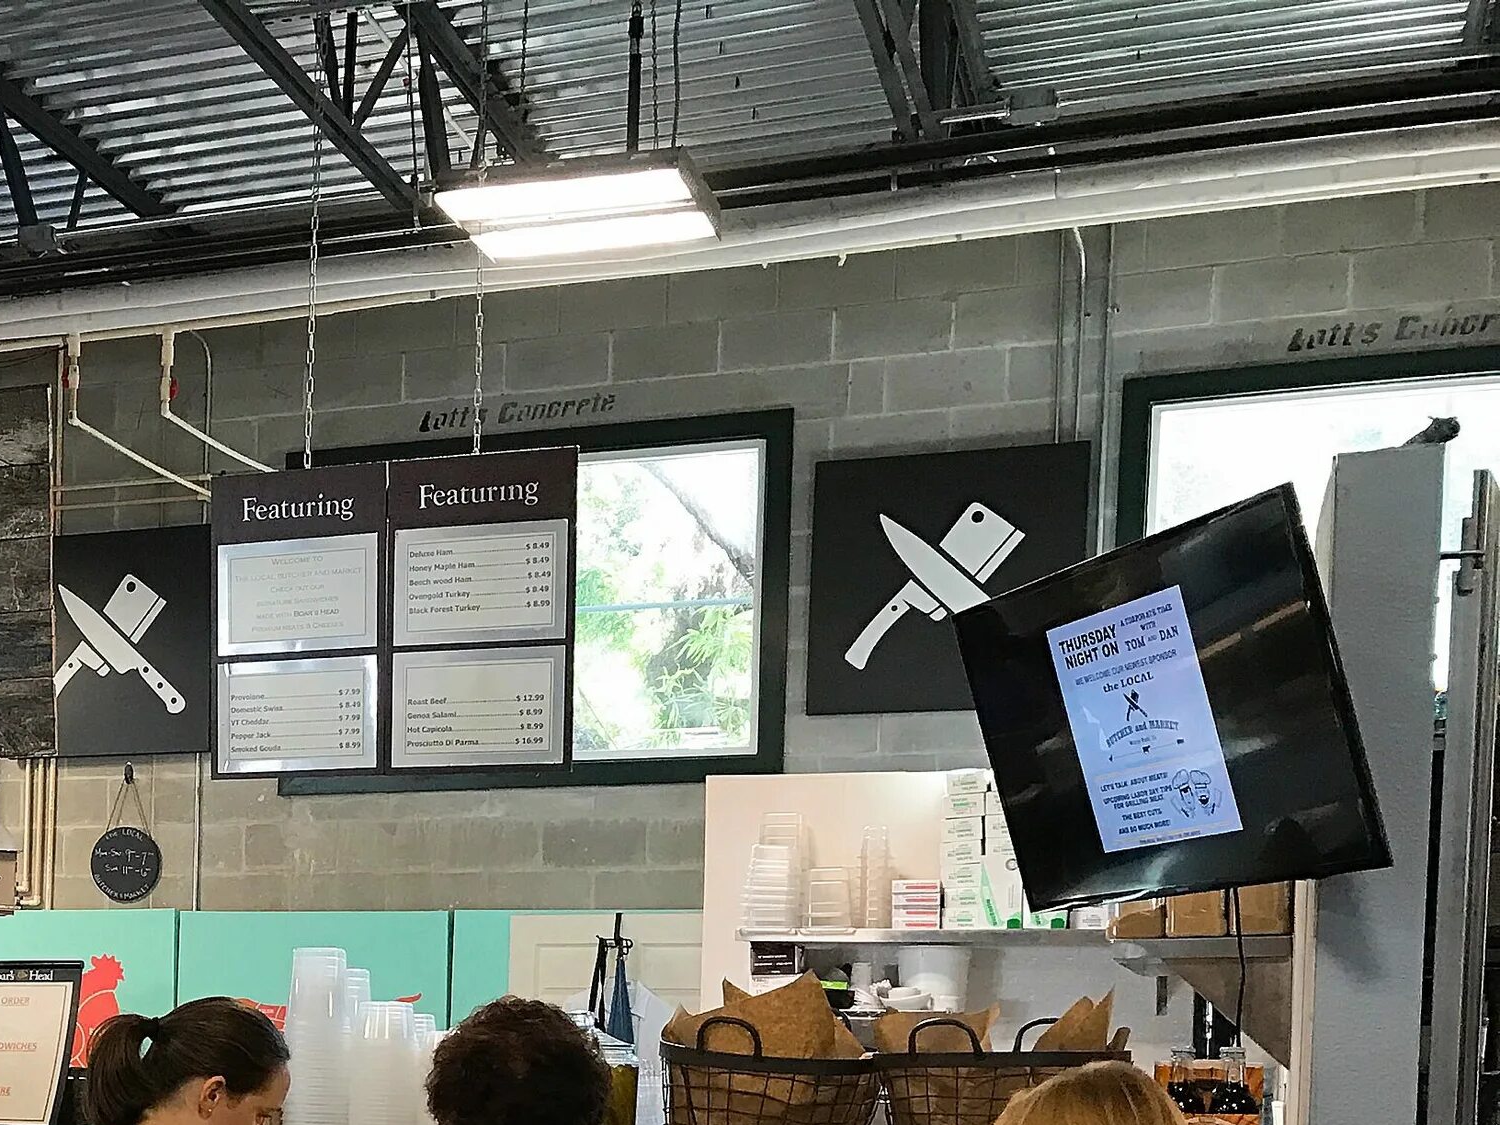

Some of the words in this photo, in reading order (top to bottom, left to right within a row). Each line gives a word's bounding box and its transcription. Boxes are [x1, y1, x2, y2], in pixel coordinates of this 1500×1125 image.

[498, 393, 616, 424] Concrete
[242, 493, 354, 522] Featuring
[419, 481, 539, 509] Featuring
[1059, 623, 1117, 654] THURSDAY
[1125, 635, 1146, 652] TOM
[1159, 625, 1179, 641] DAN
[1065, 647, 1100, 670] NIGHT
[1102, 641, 1120, 658] ON
[1103, 682, 1119, 693] the
[1120, 671, 1154, 687] LOCAL
[1135, 722, 1147, 733] and
[29, 970, 54, 981] Head
[1, 997, 30, 1005] ORDER
